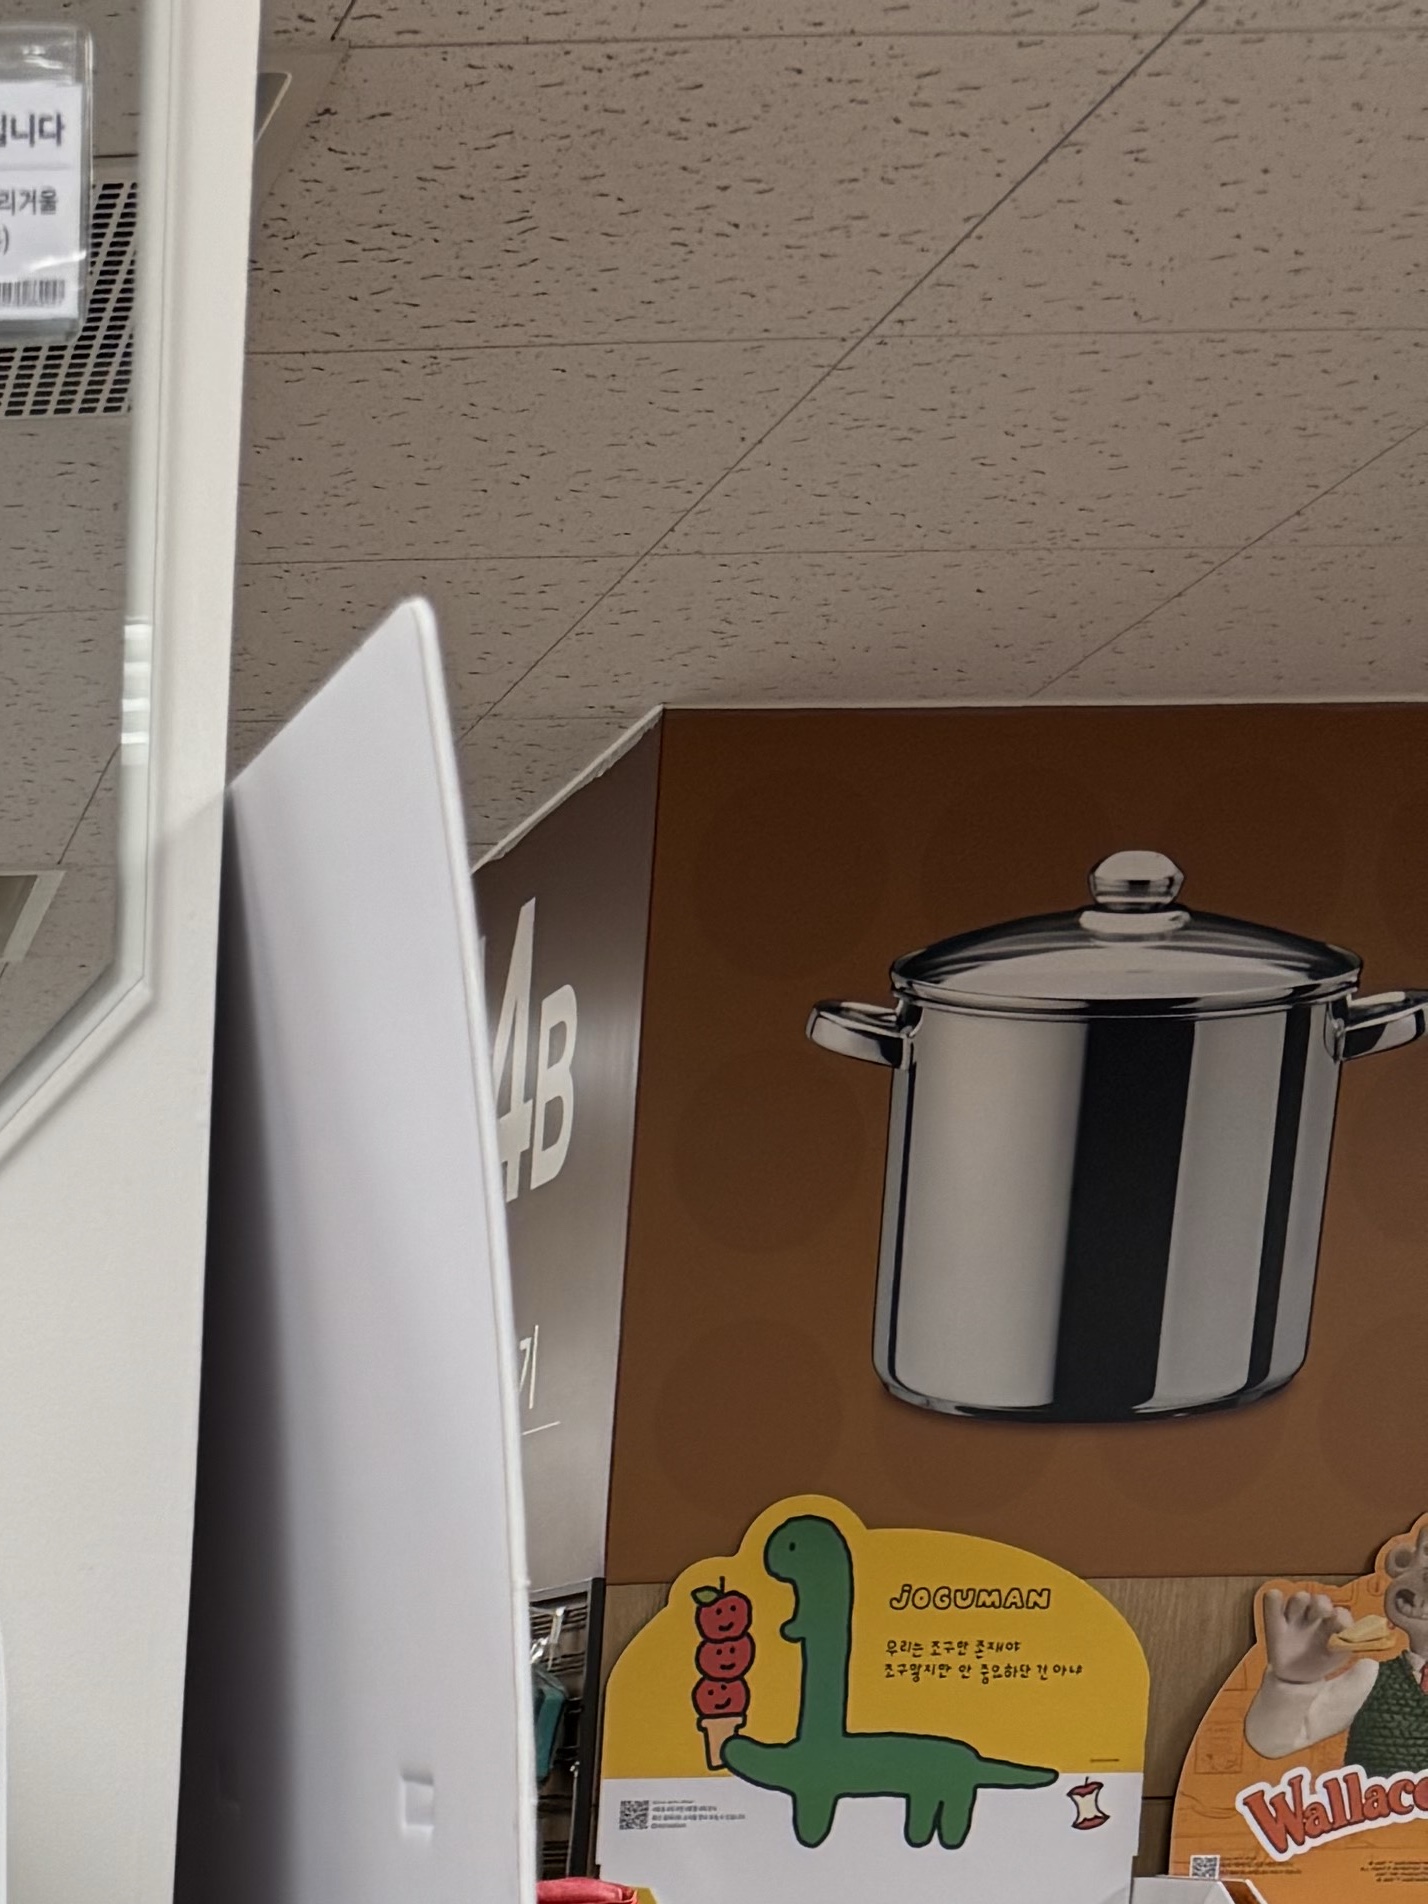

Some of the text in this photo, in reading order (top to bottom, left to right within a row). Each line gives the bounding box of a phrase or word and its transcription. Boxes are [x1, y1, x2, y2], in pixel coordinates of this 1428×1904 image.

[889, 1583, 1052, 1611] JOGUMAN
[885, 1639, 1022, 1660] 우리는 조구만 존재야
[958, 1664, 973, 1679] 안
[979, 1663, 1032, 1685] 중요하단
[1036, 1664, 1049, 1681] 건
[1052, 1663, 1084, 1677] 아냐
